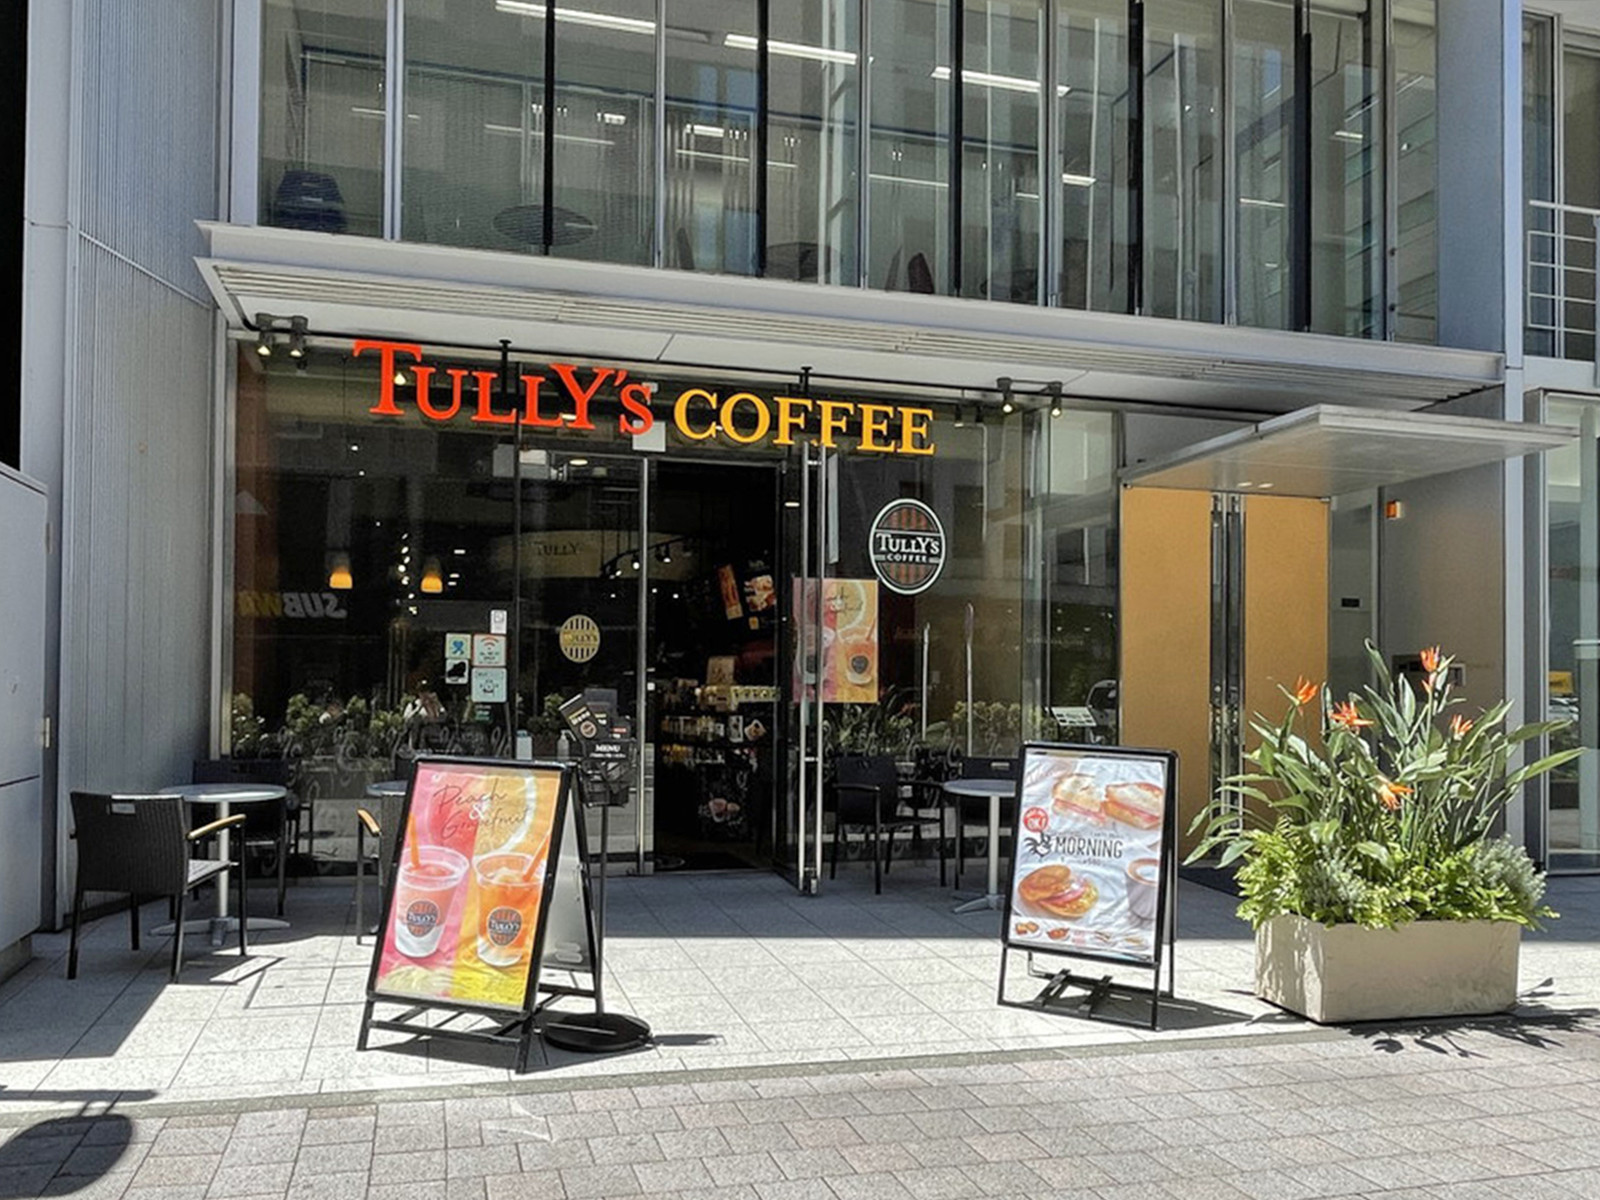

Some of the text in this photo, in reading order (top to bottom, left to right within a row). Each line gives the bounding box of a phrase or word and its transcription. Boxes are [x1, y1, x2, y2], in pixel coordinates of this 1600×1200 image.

[353, 339, 935, 455] TULLY'S COFFEE
[875, 533, 940, 554] TULLY'S
[886, 553, 928, 562] COFFEE
[432, 777, 508, 814] Peach
[1055, 836, 1123, 859] MORNING
